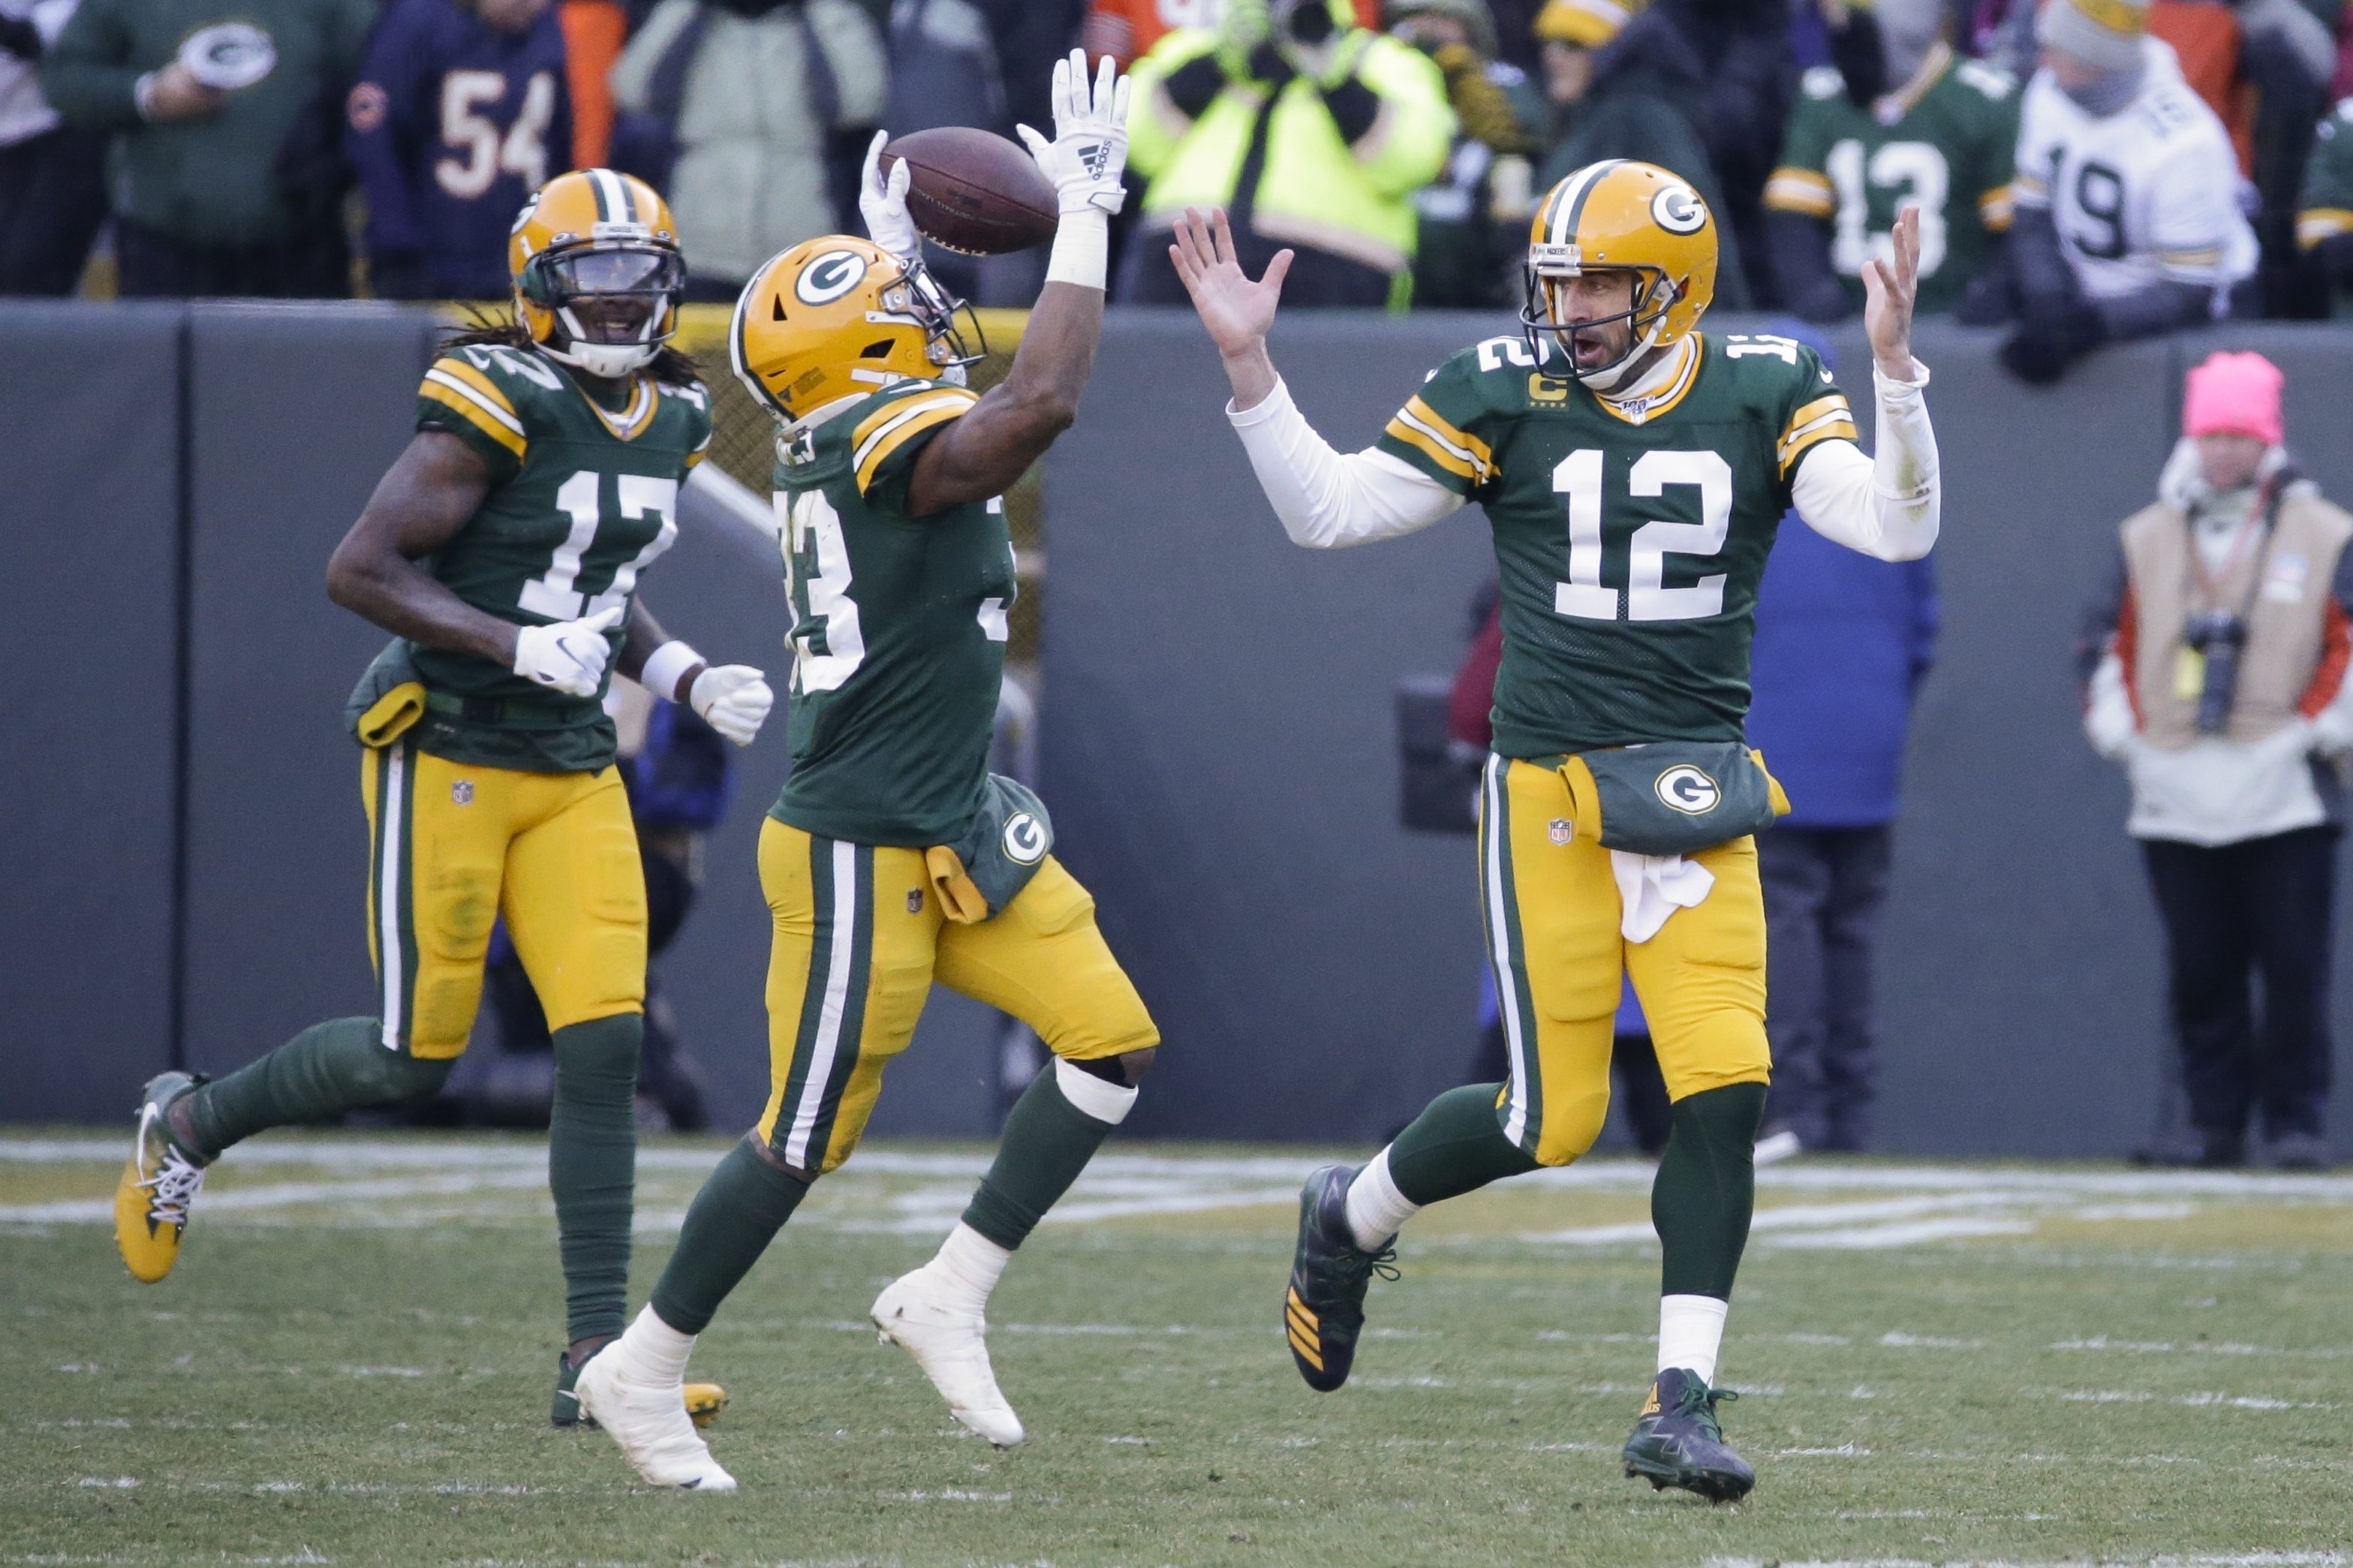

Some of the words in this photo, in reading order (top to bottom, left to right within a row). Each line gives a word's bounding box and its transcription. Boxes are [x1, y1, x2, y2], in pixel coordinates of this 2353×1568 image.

[435, 69, 557, 200] 54
[1092, 140, 1112, 181] adidas
[1653, 187, 1705, 231] G
[1825, 138, 1950, 279] 13
[796, 250, 865, 303] G
[1528, 373, 1568, 401] C
[517, 470, 679, 627] 17
[1552, 449, 1733, 621] 12
[1659, 768, 1717, 811] G
[1004, 814, 1046, 861] G
